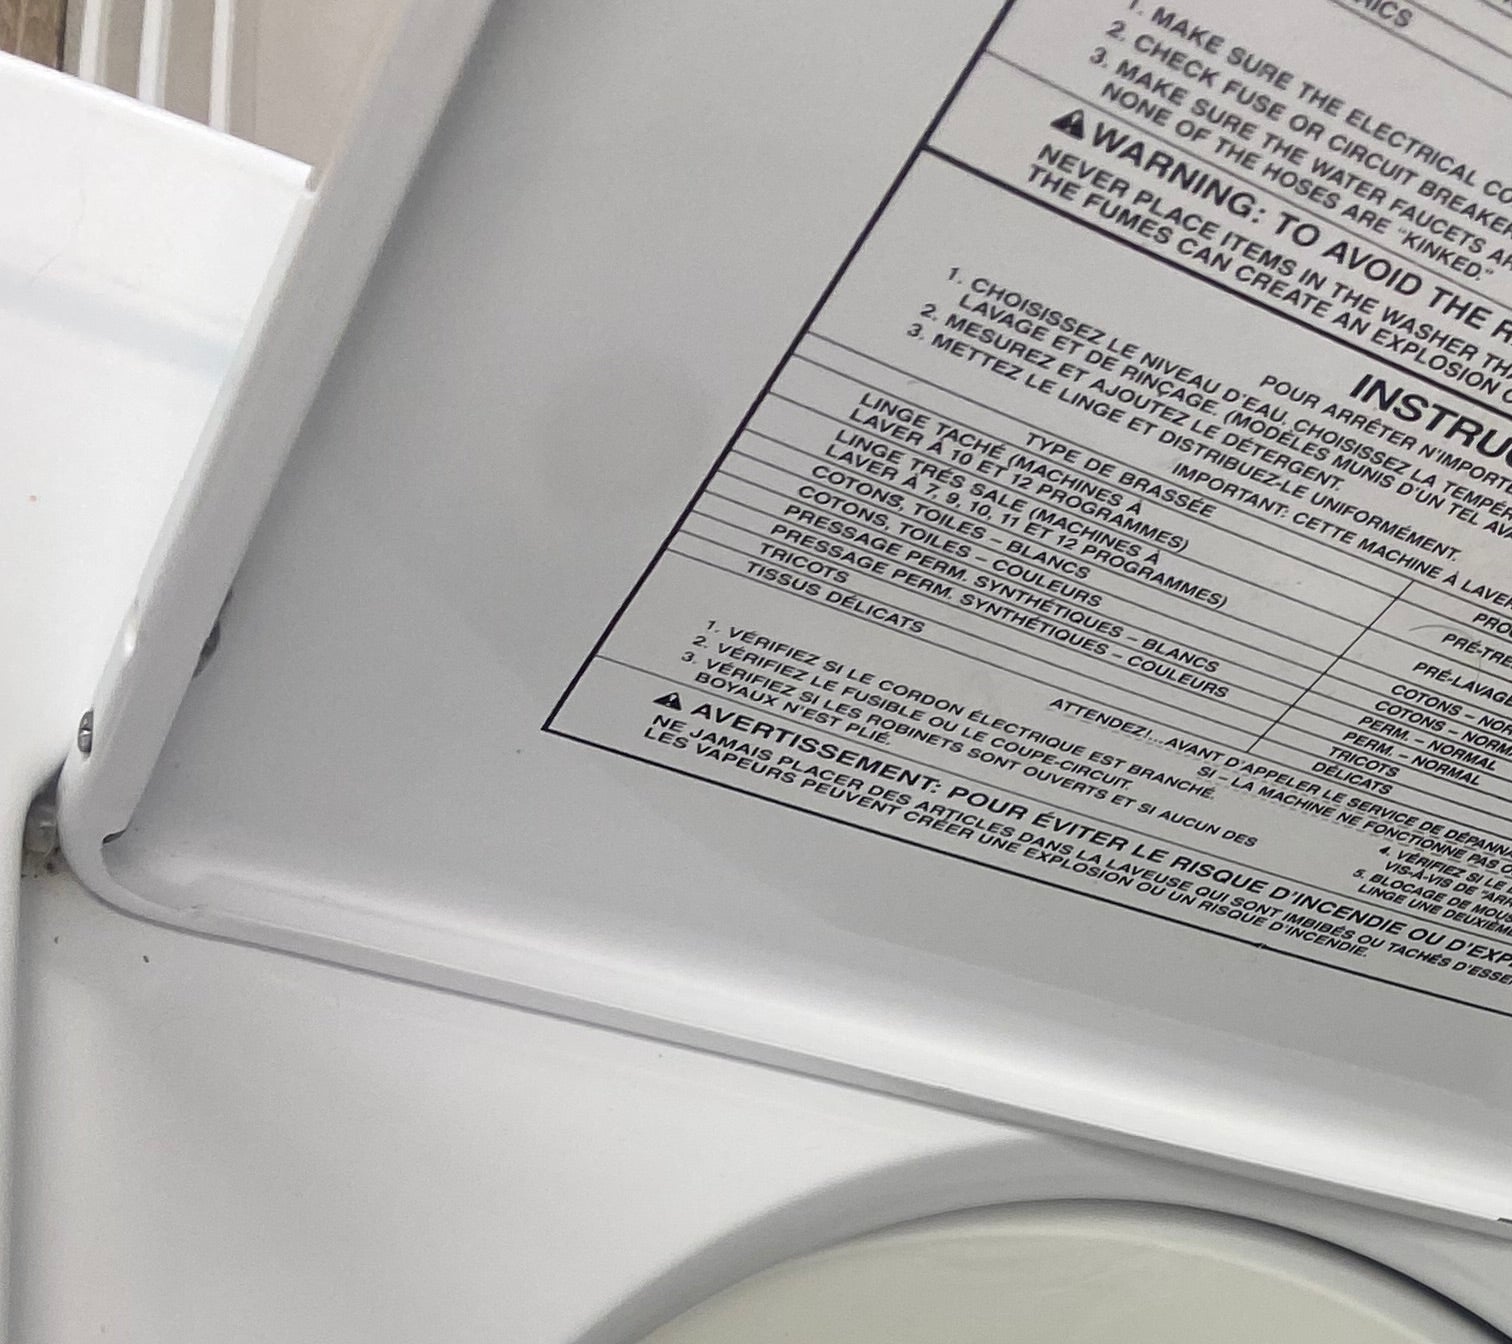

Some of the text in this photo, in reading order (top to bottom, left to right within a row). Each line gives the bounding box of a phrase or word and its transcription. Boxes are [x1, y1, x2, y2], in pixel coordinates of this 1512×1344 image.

[1037, 143, 1130, 198] NEVER
[1132, 189, 1220, 240] PLACE
[1219, 231, 1297, 277] ITEMS
[1298, 268, 1327, 291] IN
[1331, 281, 1380, 315] THE
[1380, 306, 1479, 362] WASHER
[1092, 121, 1266, 224] WARNING:
[1274, 211, 1320, 247] TO
[1321, 240, 1422, 296] AVOID
[1428, 285, 1493, 330] THE
[1025, 431, 1217, 518] TYPE DE BRASSÉE
[747, 560, 931, 633] TISSUS DÉLICATS
[760, 542, 850, 584] TRICOTS
[689, 703, 942, 794] AVERTISSEMENT:
[946, 785, 1028, 820] POUR
[1030, 811, 1129, 851] ÉVITER
[1130, 843, 1170, 863] LE
[1168, 855, 1269, 894] RISQUE
[1268, 886, 1408, 935] D'INCENDIE
[1407, 927, 1446, 946] OU
